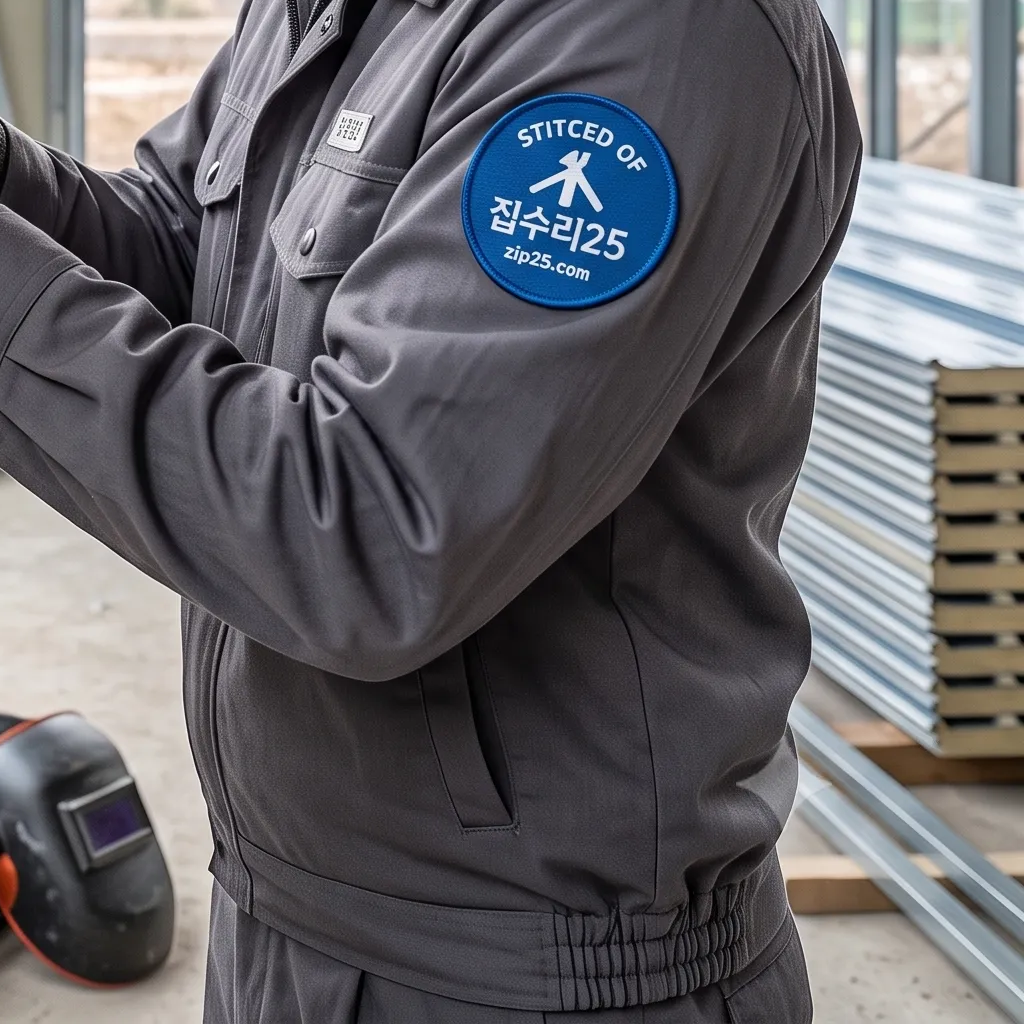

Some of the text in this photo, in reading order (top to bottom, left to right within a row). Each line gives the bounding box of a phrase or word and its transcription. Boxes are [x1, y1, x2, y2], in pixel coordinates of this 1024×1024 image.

[517, 119, 648, 172] STITCED OF
[489, 196, 629, 261] 집수리25
[503, 245, 590, 282] zip25.com
